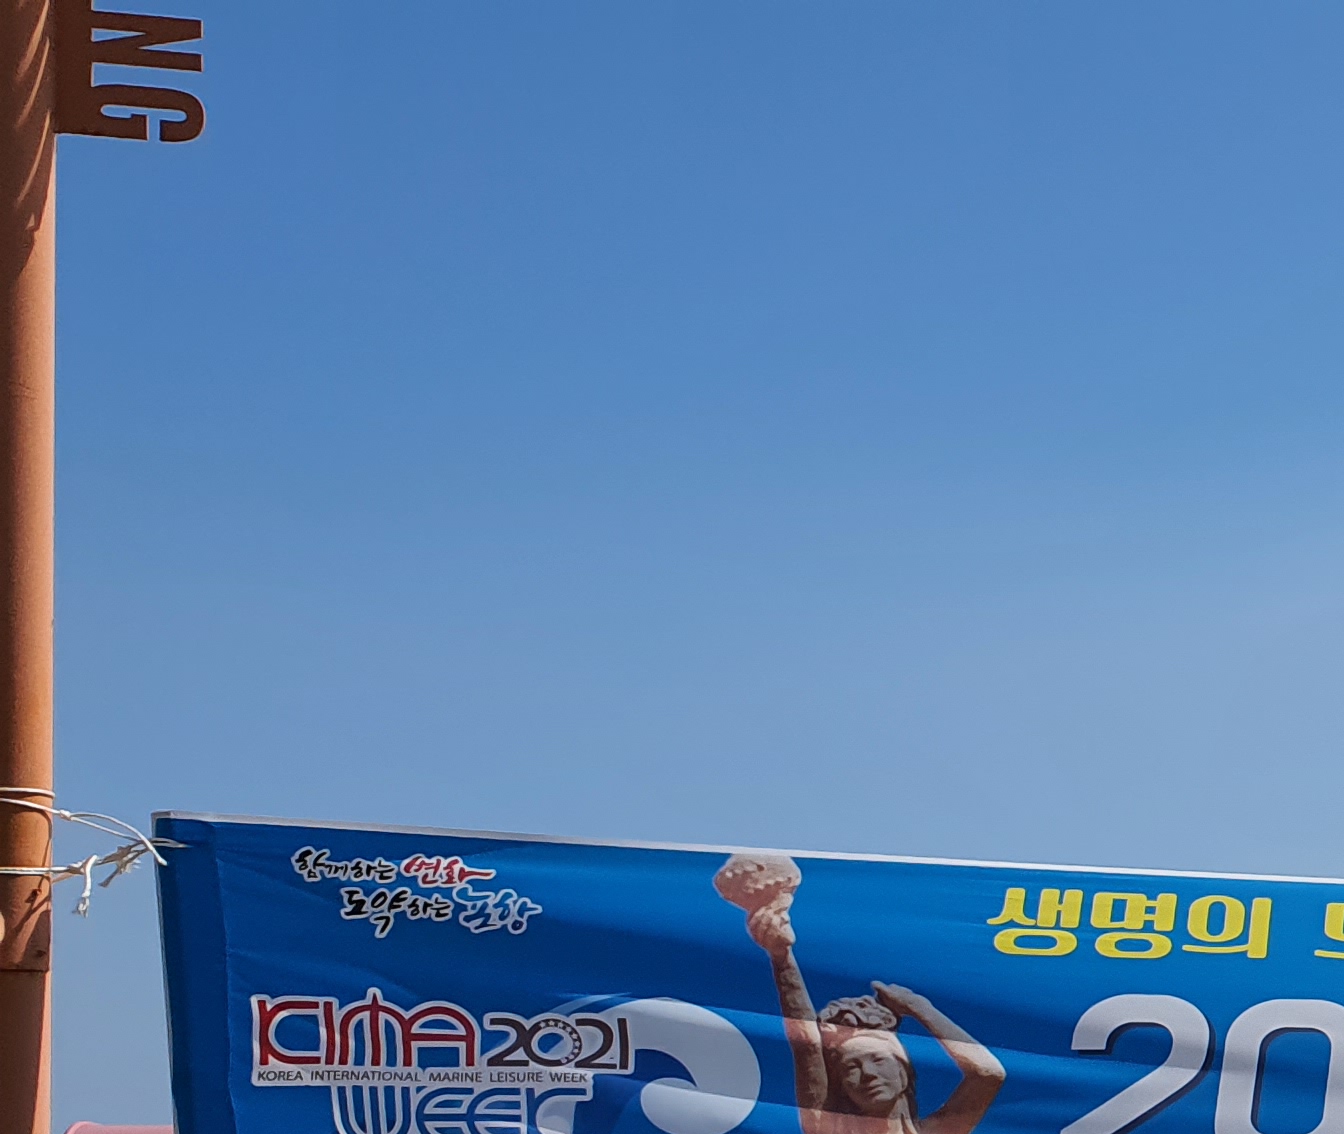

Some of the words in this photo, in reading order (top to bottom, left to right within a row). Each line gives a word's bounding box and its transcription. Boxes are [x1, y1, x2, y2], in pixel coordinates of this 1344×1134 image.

[293, 848, 397, 880] 함께하는
[403, 854, 494, 885] 변화
[341, 887, 452, 937] 도약하는
[454, 885, 541, 933] 포항
[986, 888, 1272, 960] 생명의
[257, 993, 476, 1067] KIMA
[487, 1017, 629, 1070] 2021
[257, 1070, 304, 1083] KOREA
[310, 1070, 421, 1083] INTERNATIONAL
[429, 1071, 483, 1083] MARINE
[489, 1071, 544, 1083] LEISURE
[549, 1072, 588, 1083] WEEK
